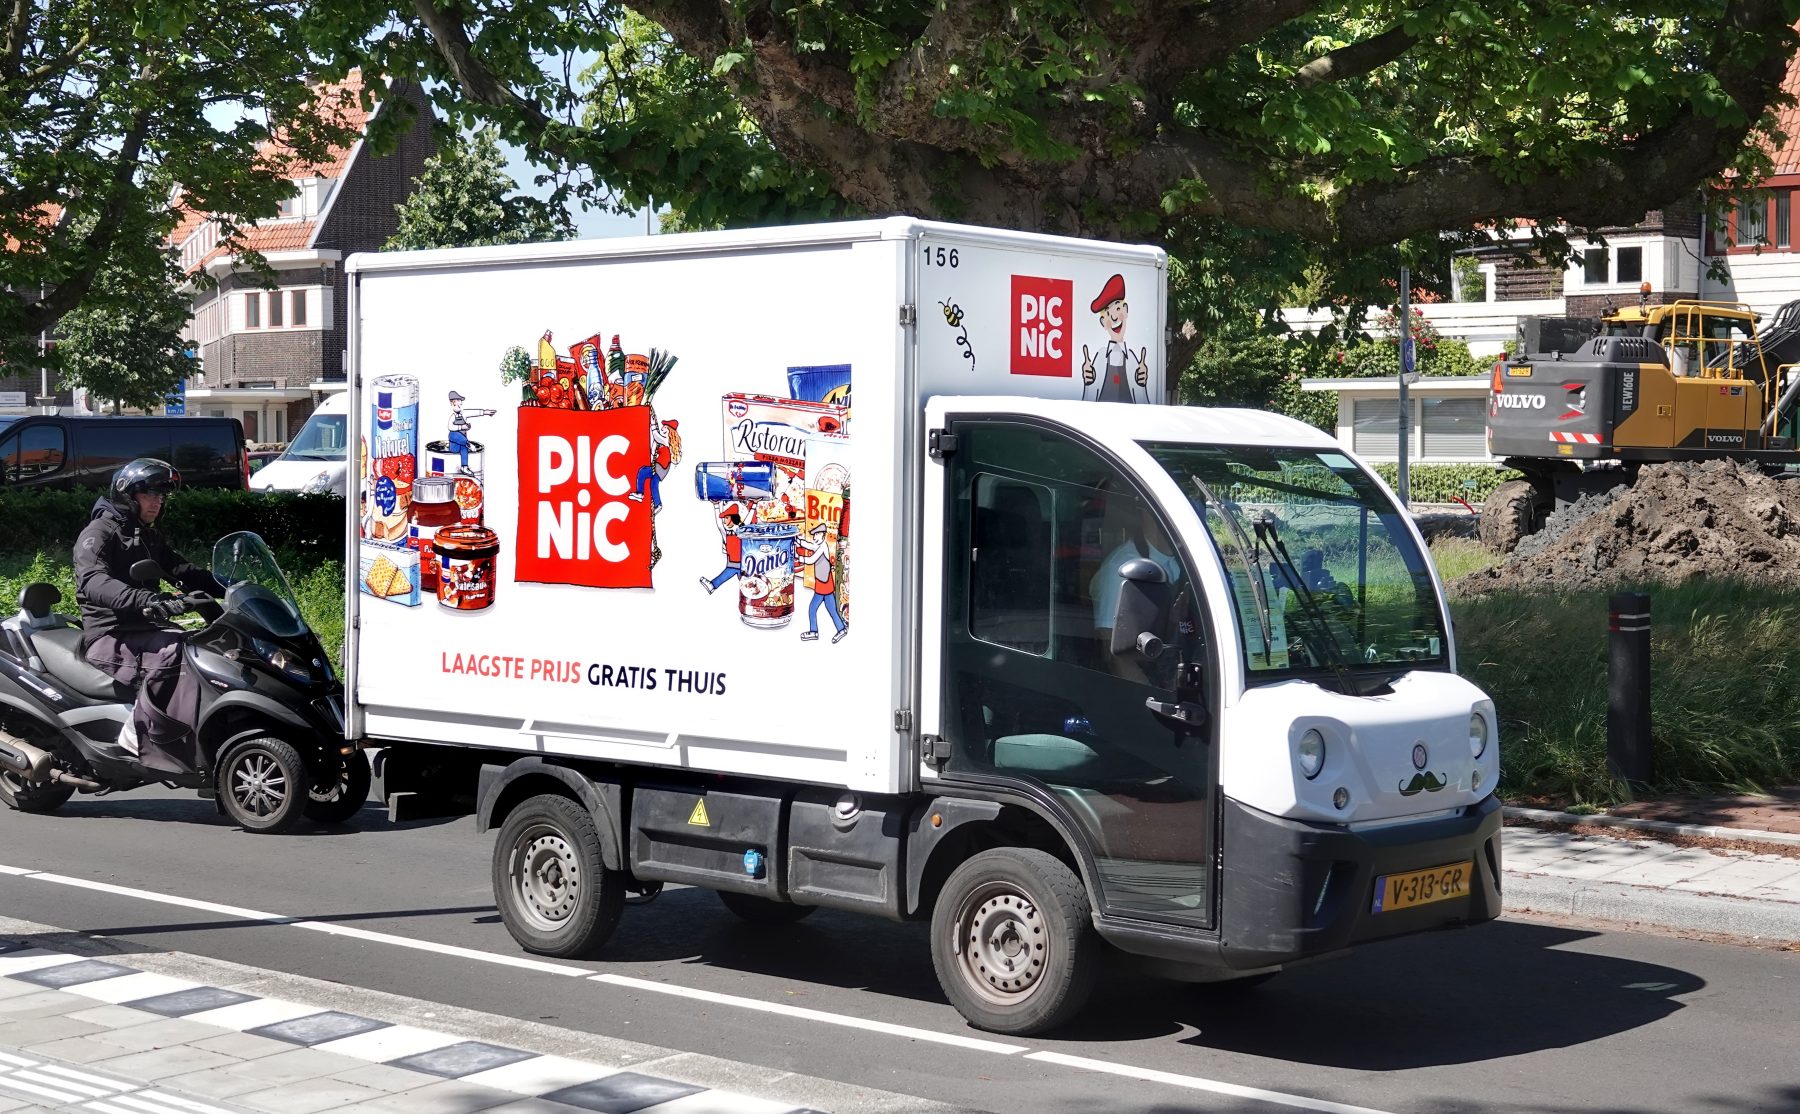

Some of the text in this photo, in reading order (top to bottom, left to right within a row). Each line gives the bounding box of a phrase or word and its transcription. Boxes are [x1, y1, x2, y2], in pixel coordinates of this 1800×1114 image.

[923, 246, 959, 268] 156
[1496, 394, 1546, 409] VOLVO
[1622, 371, 1634, 404] EW160E
[1708, 435, 1743, 443] VOLVO
[745, 547, 789, 577] Danio
[442, 652, 726, 695] LAAGSTE PRIJS GRATIS THUIS
[1393, 868, 1462, 905] V-313-GR
